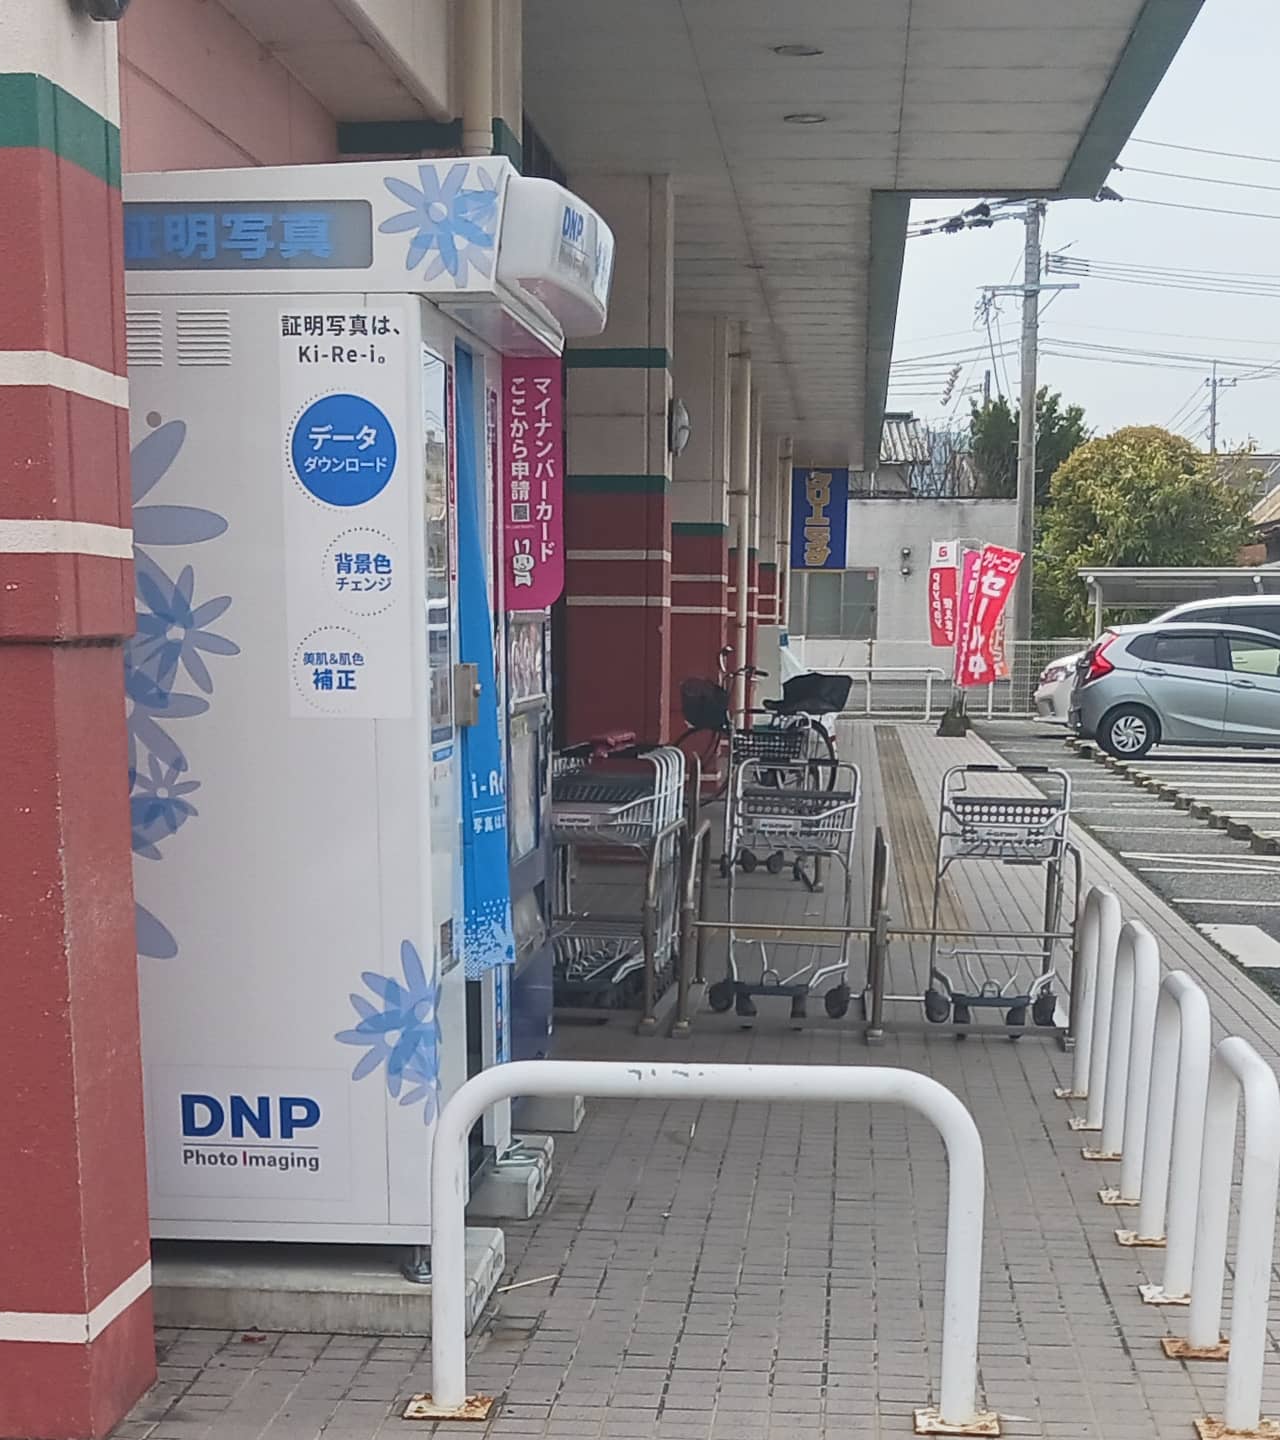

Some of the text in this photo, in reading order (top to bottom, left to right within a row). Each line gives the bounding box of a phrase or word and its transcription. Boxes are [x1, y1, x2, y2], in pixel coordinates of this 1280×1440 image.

[562, 206, 584, 242] DNP
[281, 314, 400, 336] 証明写真は、
[308, 424, 377, 450] データ
[510, 377, 530, 501] ここから申請
[304, 456, 387, 473] ダウンロード
[533, 377, 556, 563] マイナンバーカード
[334, 552, 392, 574] 背景色
[335, 577, 392, 591] チェンジ
[968, 569, 1006, 680] セール中
[303, 652, 365, 666] 美肌&肌色
[312, 668, 357, 690] 補正
[181, 1094, 320, 1138] DNP
[183, 1150, 320, 1172] Photo Imaging
